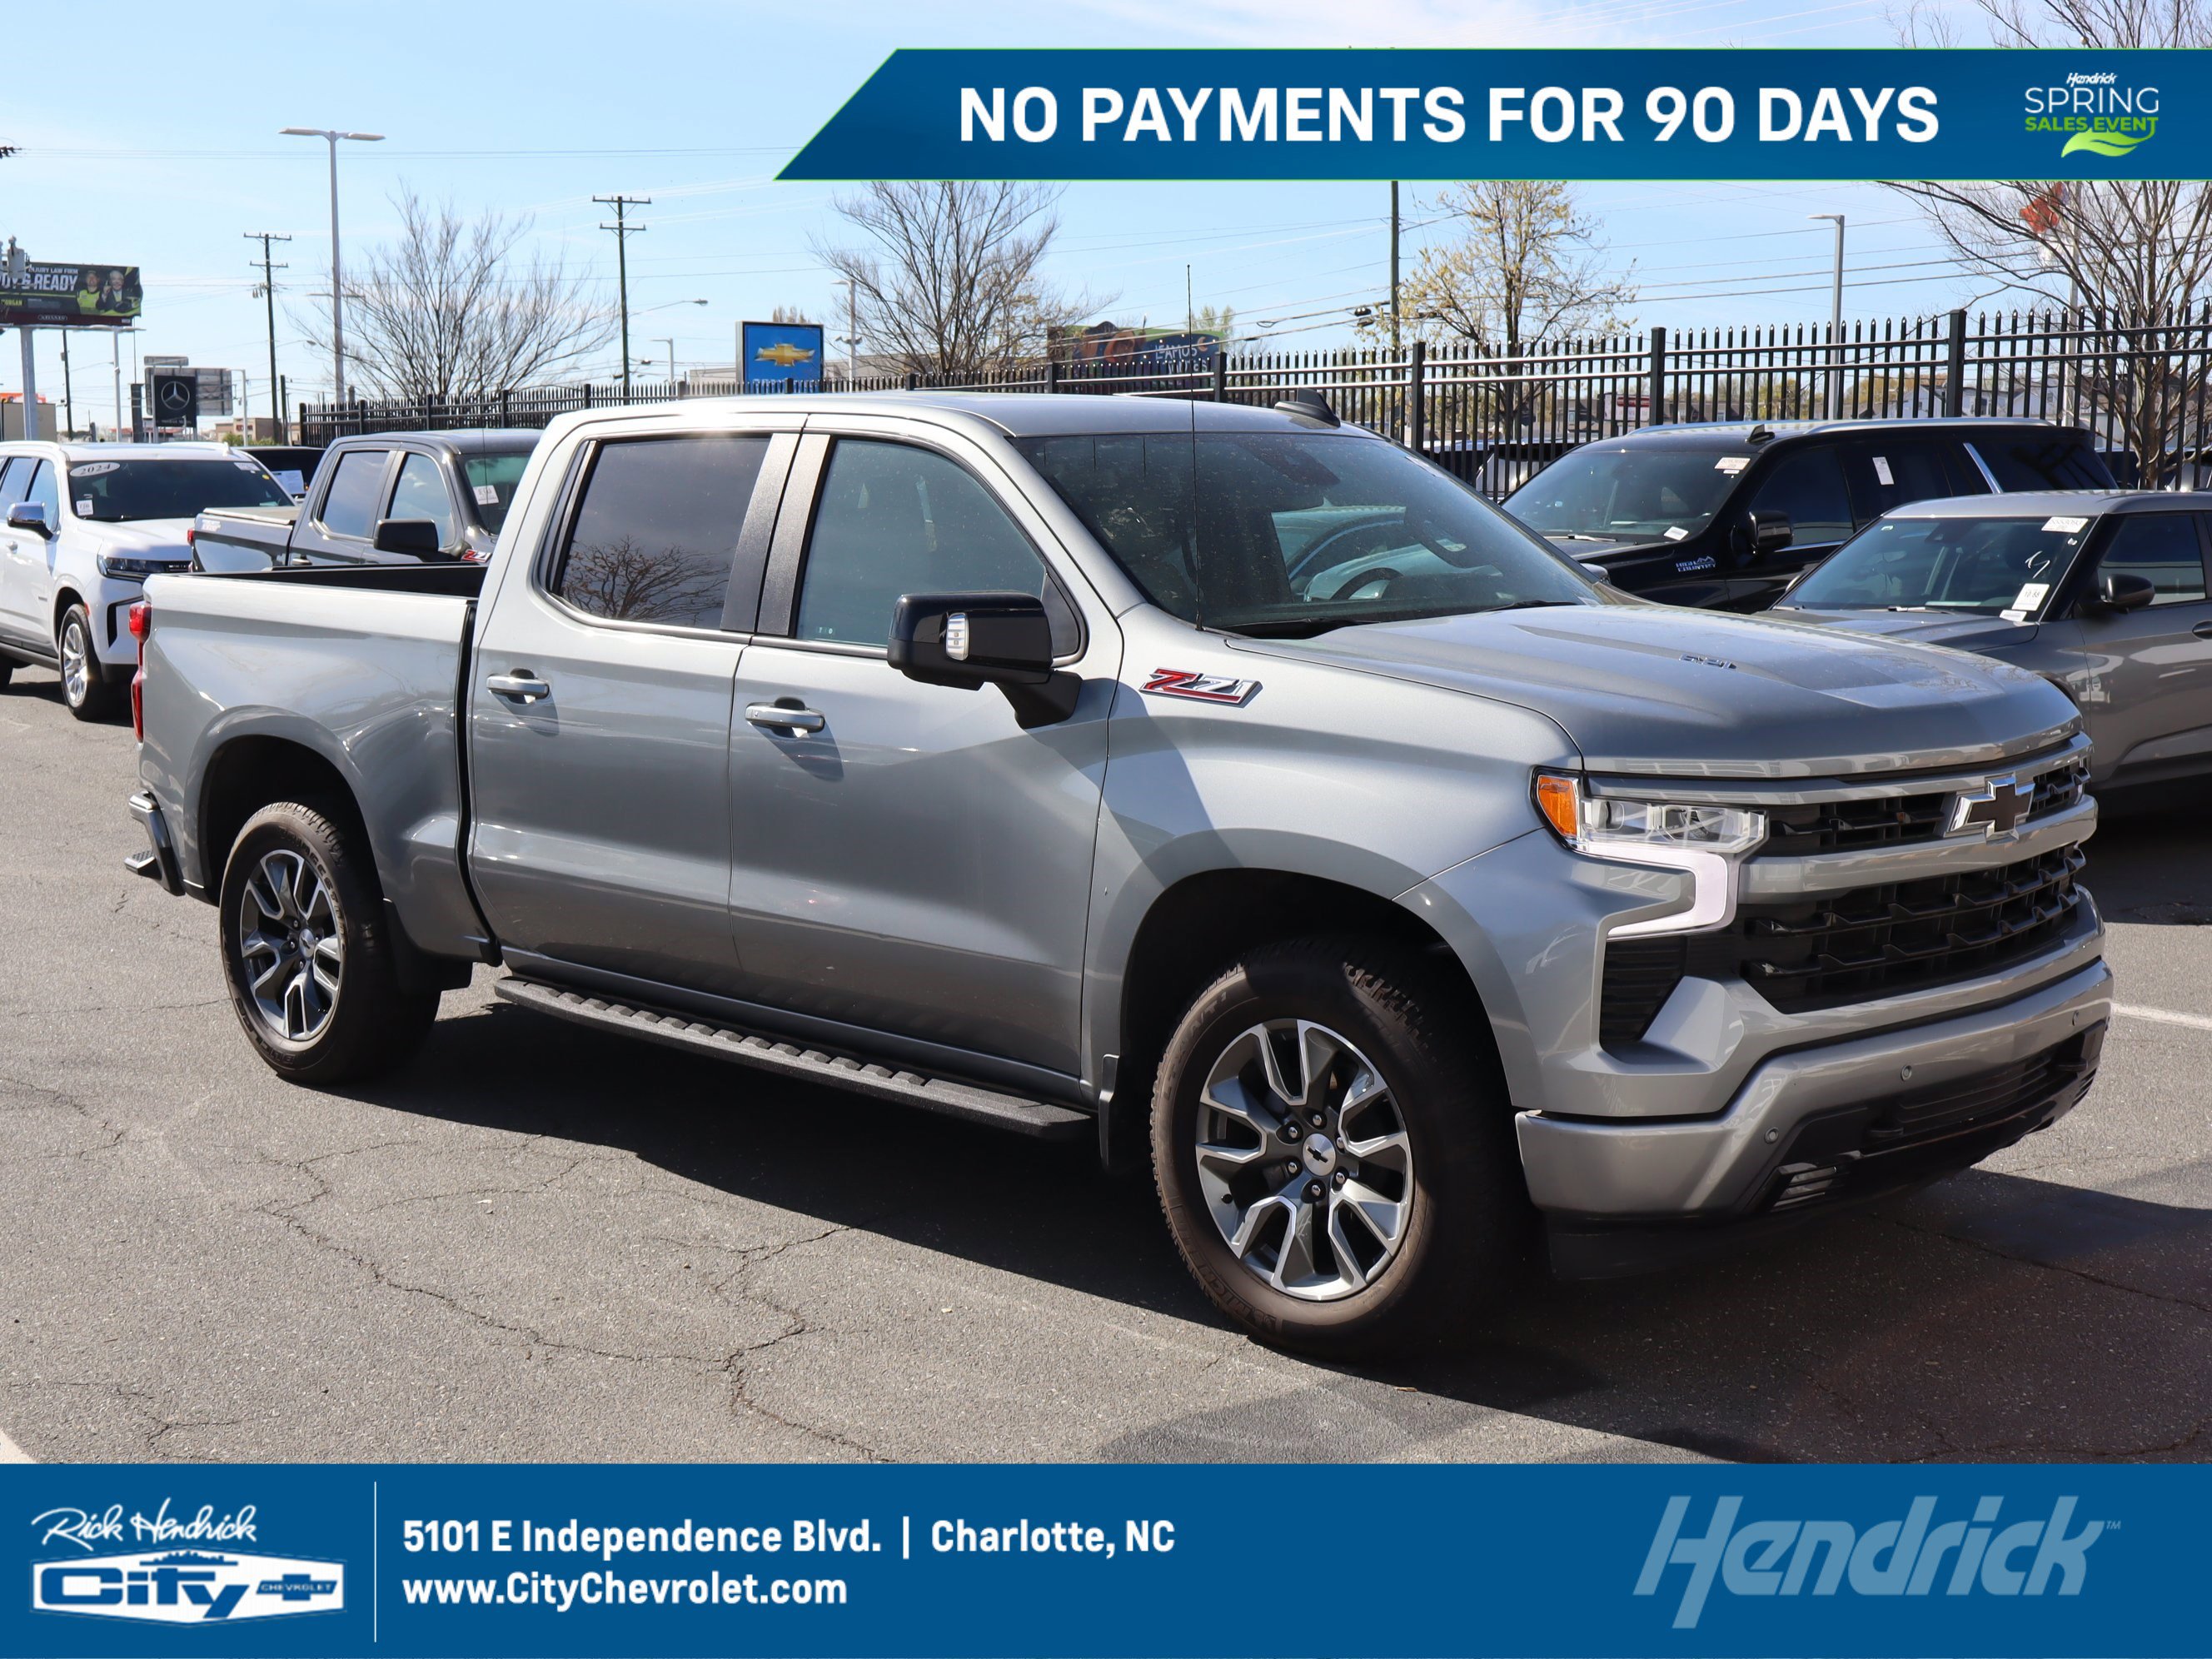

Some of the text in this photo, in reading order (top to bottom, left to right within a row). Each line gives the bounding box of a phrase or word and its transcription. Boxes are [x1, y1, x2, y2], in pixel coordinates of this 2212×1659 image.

[33, 272, 78, 291] READY
[79, 463, 111, 475] 2024
[1138, 667, 1263, 705] Z71
